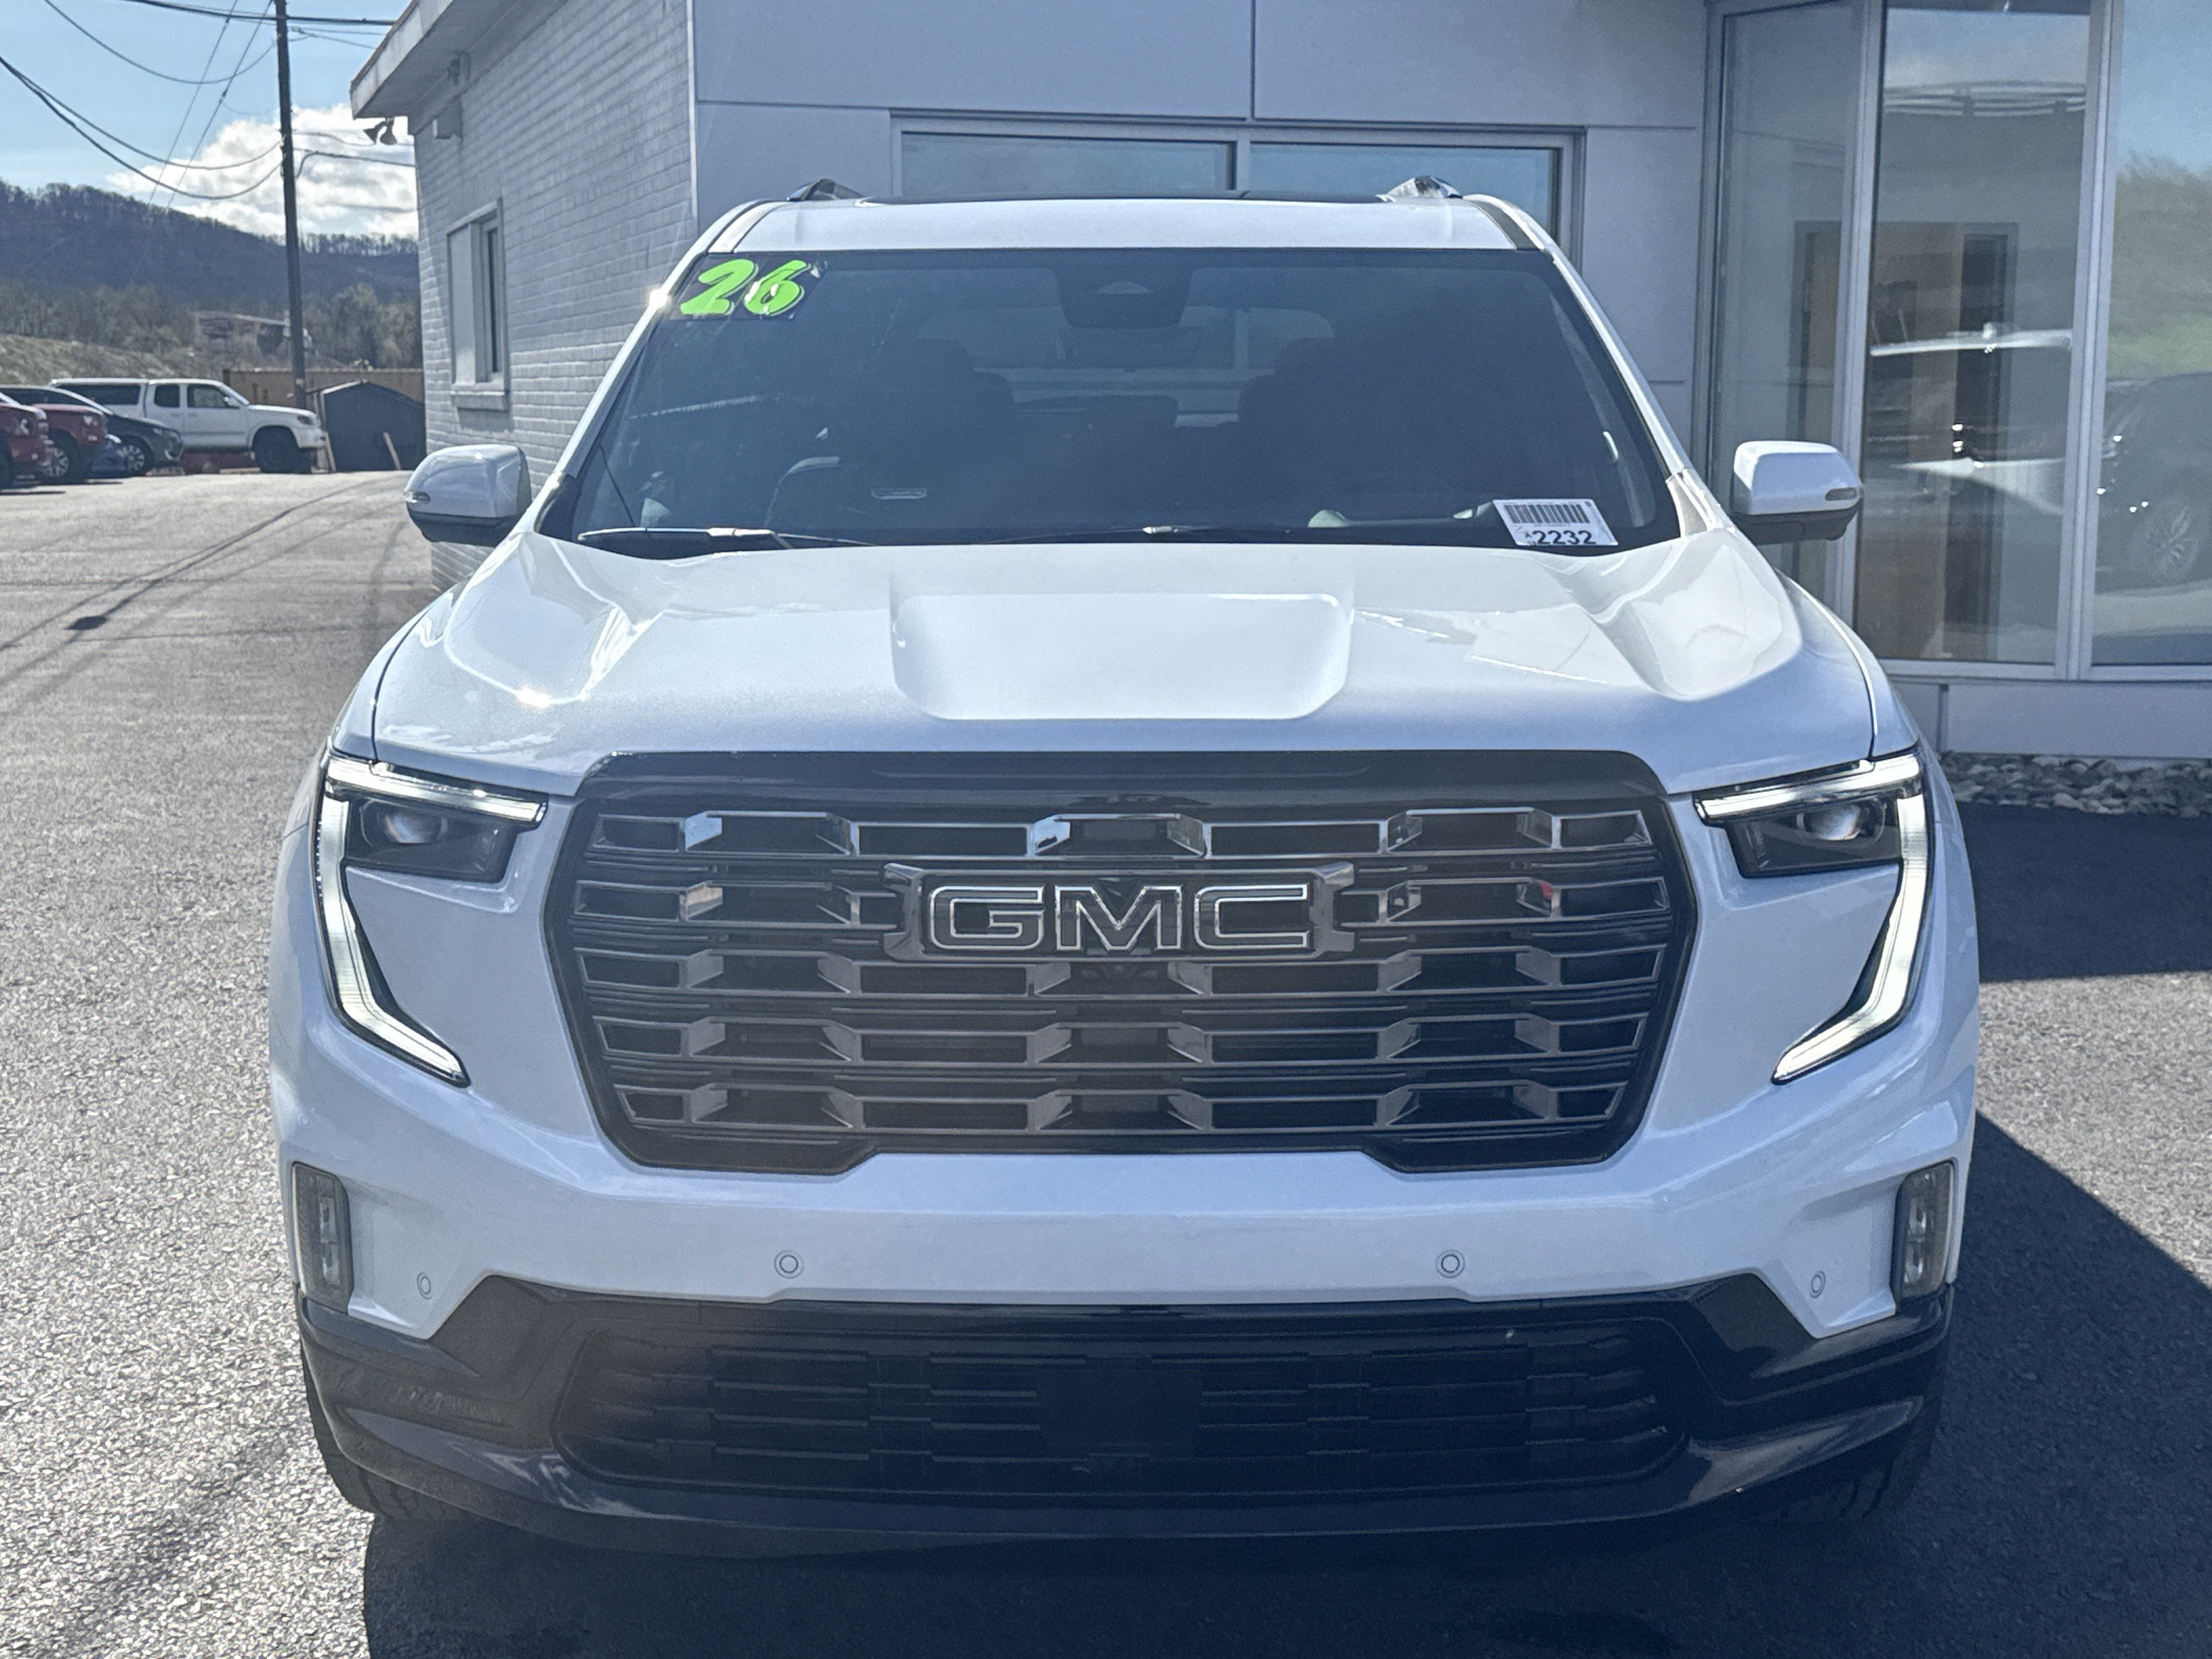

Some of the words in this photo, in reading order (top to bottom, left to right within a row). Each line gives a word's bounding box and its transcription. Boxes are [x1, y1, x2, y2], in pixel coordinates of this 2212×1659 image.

[680, 259, 810, 315] 26
[1532, 530, 1596, 544] 2232
[930, 884, 1311, 951] GMC
